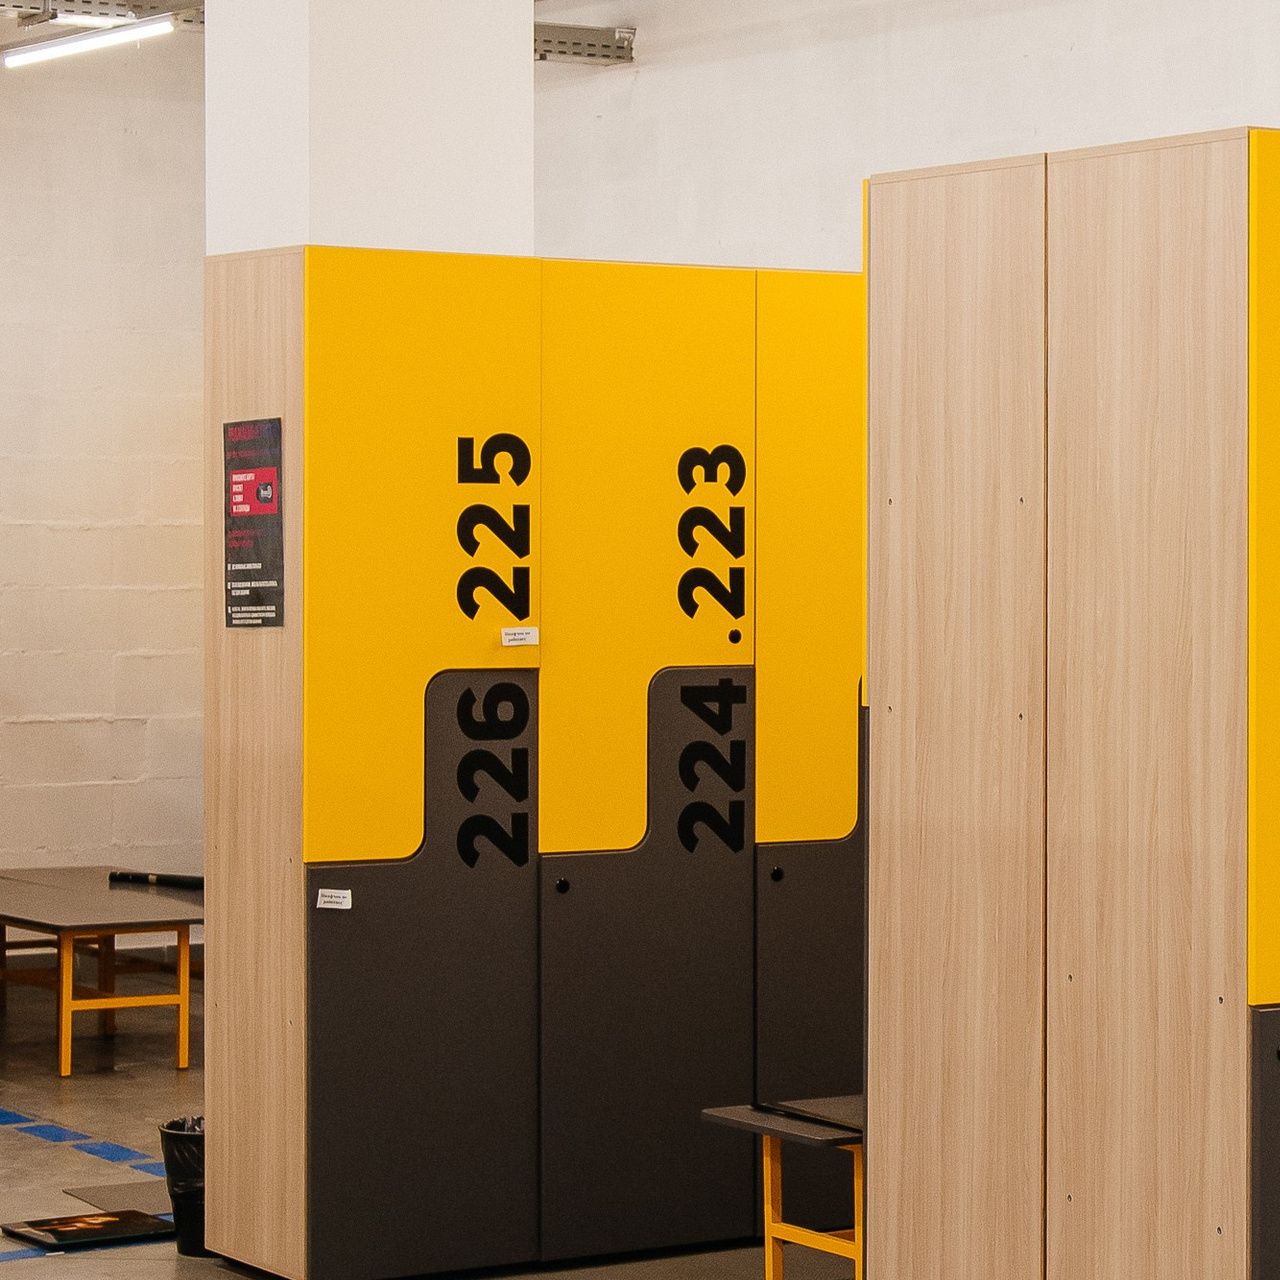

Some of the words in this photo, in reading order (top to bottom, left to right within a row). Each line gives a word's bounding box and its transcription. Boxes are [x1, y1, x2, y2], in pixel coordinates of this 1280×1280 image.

[457, 432, 532, 622] 225
[677, 444, 747, 620] 223
[456, 681, 530, 870] 226
[677, 677, 748, 855] 224
